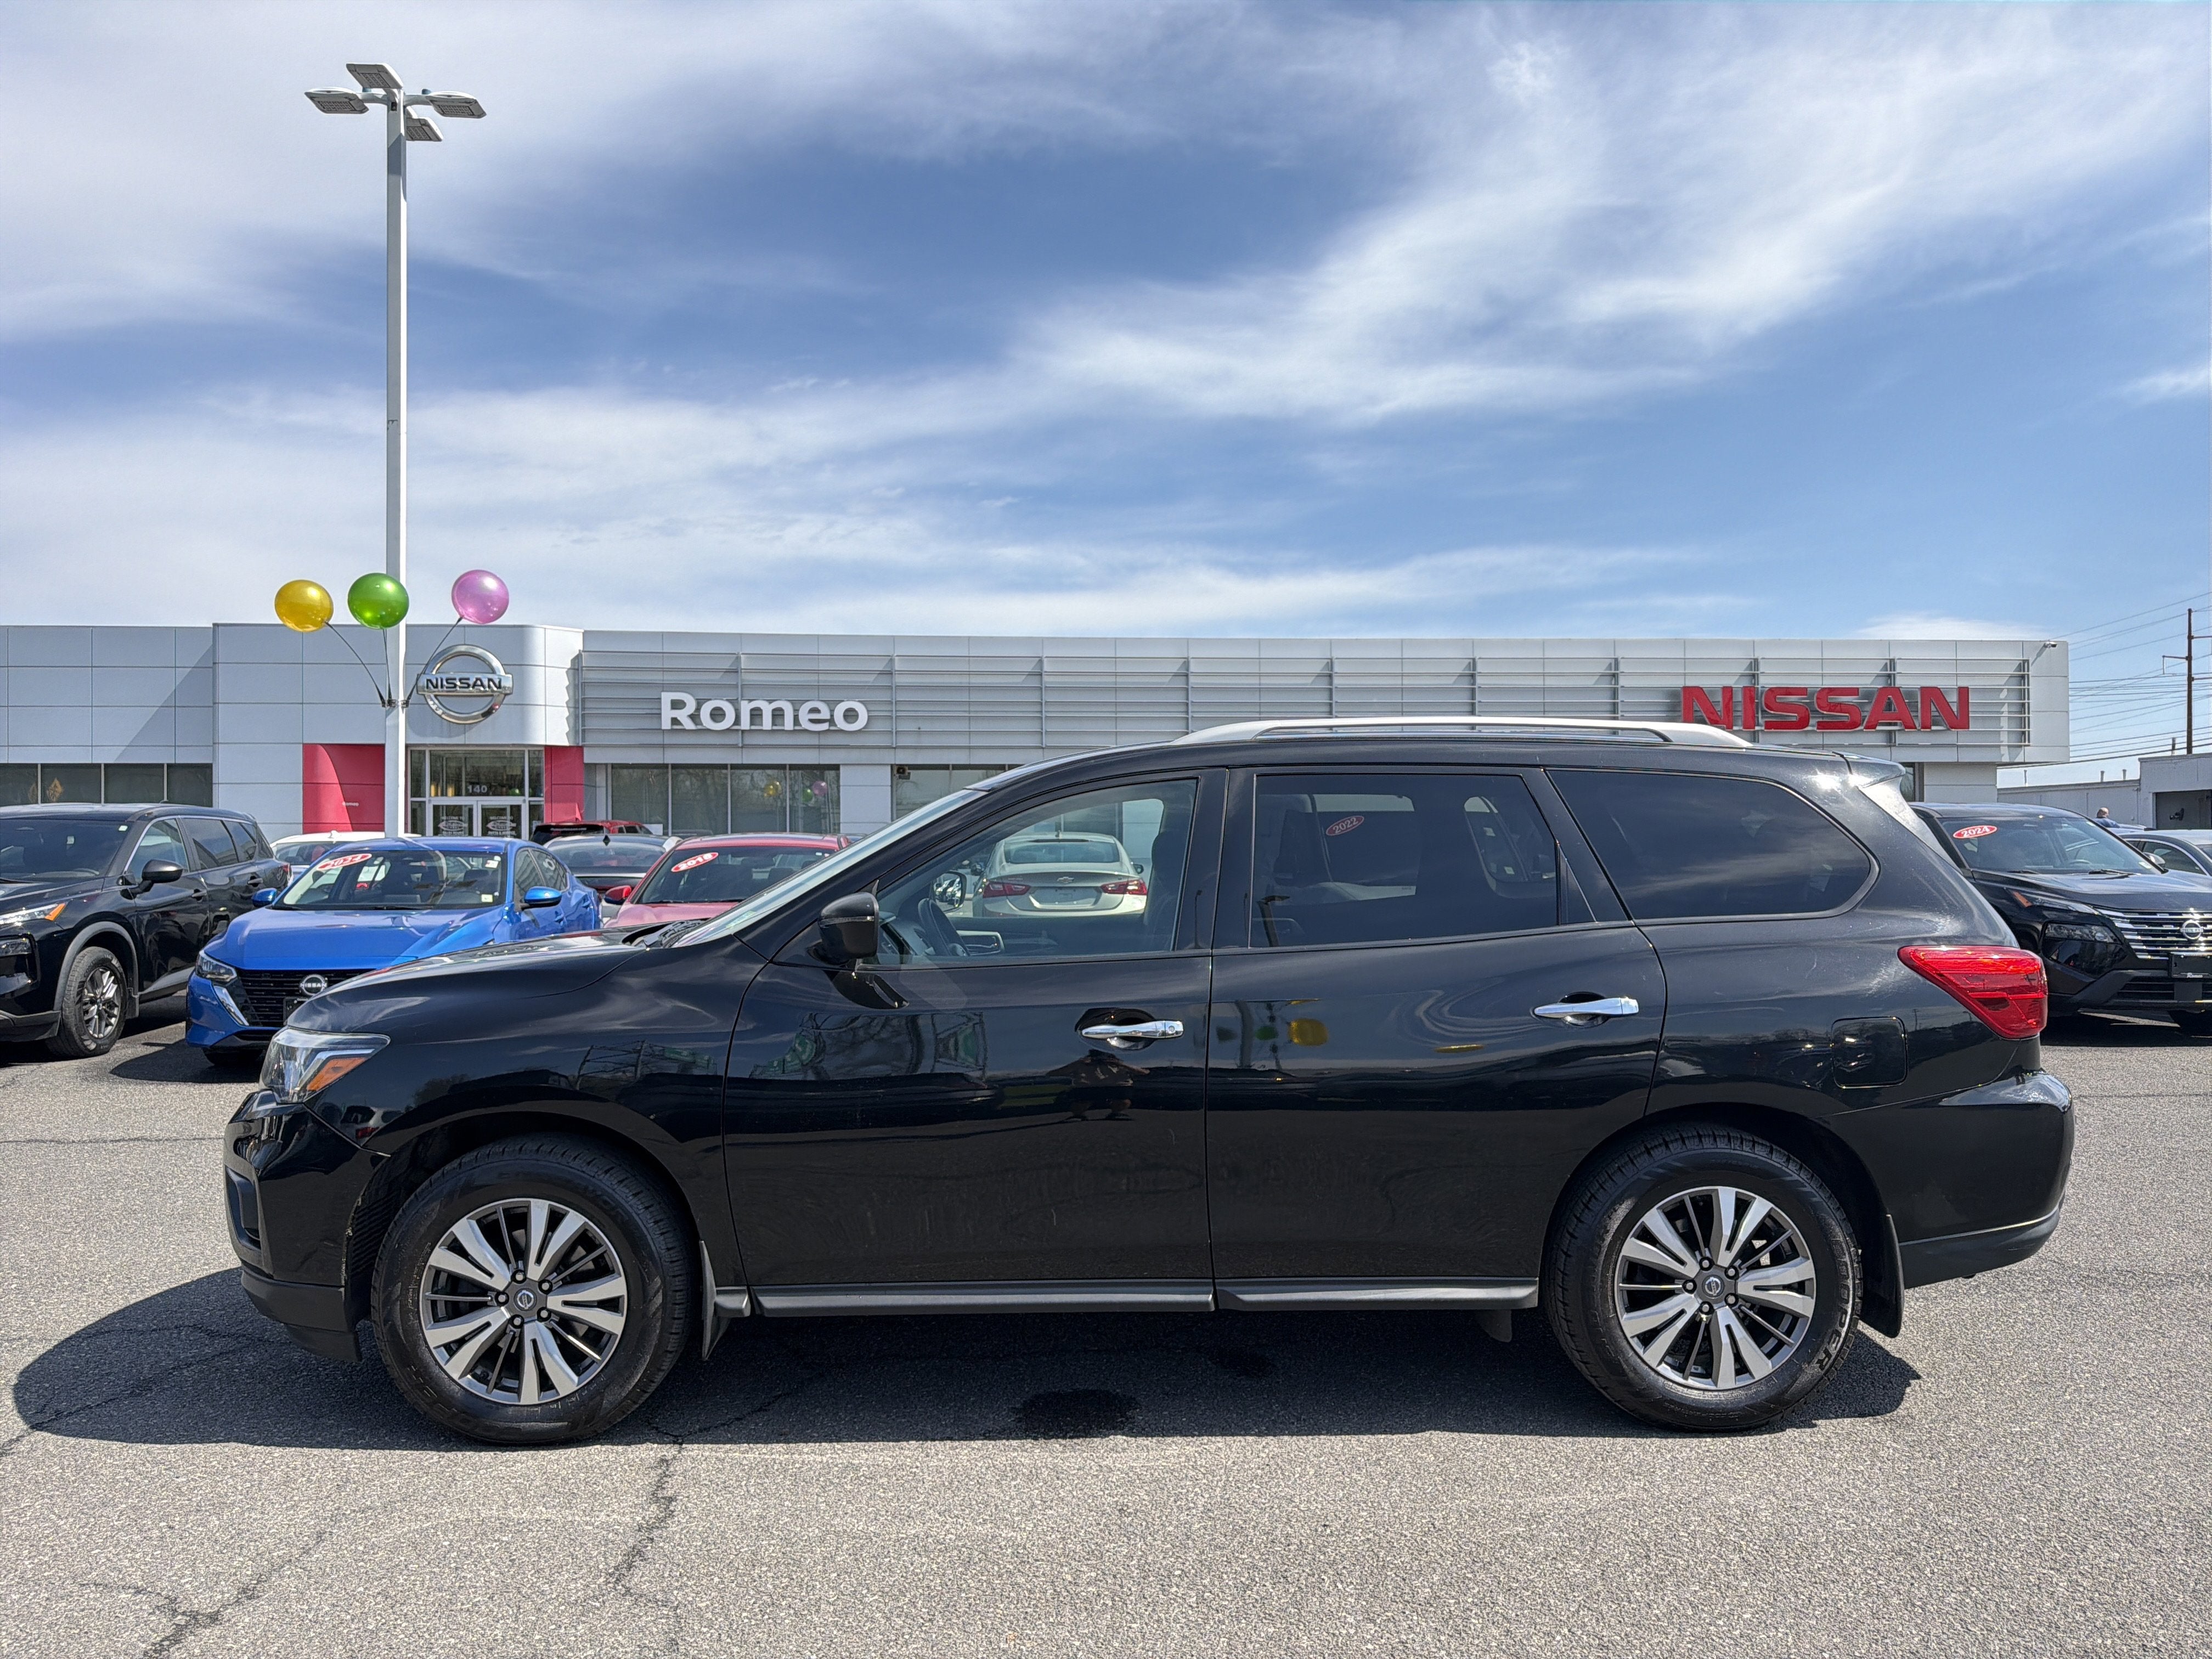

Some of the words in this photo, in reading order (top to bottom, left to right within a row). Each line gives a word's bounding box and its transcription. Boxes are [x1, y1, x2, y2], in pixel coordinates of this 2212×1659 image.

[426, 677, 502, 690] NISSAN
[661, 691, 868, 731] Romeo
[1681, 686, 1970, 732] NISSAN
[467, 785, 488, 793] 140
[1333, 817, 1358, 833] 2022
[1961, 826, 1990, 837] 2024
